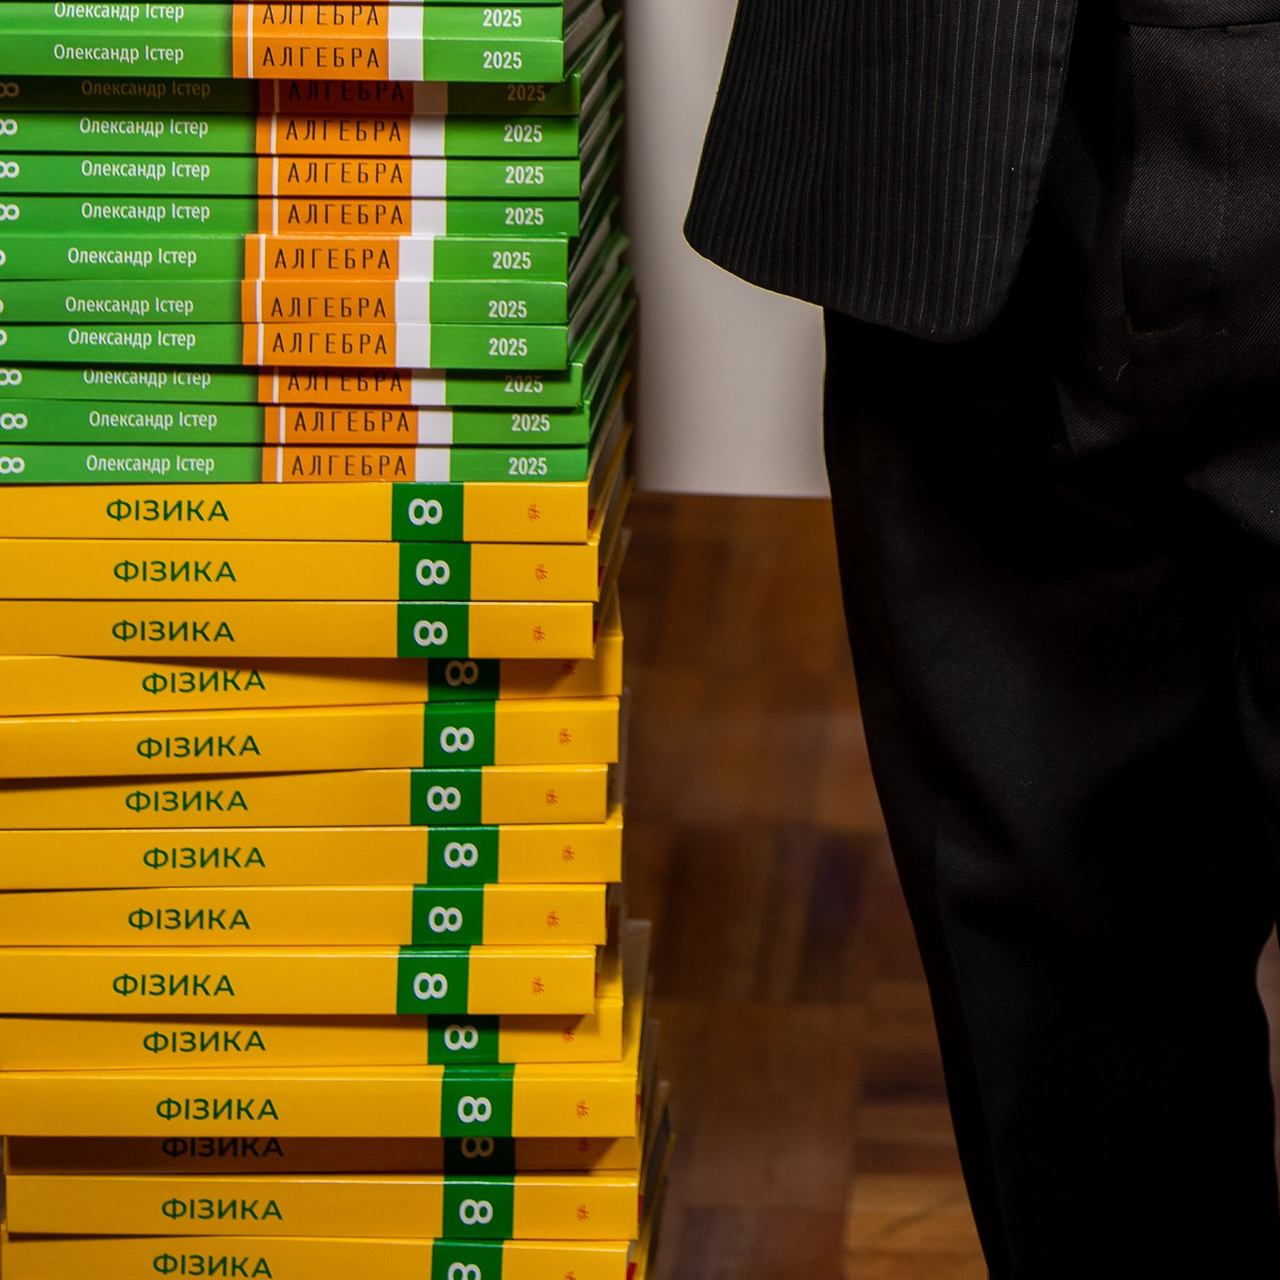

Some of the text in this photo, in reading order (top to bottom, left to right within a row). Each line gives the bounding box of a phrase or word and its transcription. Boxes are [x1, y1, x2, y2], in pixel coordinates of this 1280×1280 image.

[55, 2, 522, 27] Олександр Істер АЛГЕБРА 2025
[54, 44, 522, 69] Олександр Істер АЛГЕБРА 2025
[80, 117, 542, 142] Олександр Істер АЛГЕБРА 2025
[82, 160, 544, 184] Олександр Істер АЛГЕБРА 2025
[82, 202, 544, 225] Олександр Істер АЛГЕБРА 2025
[68, 247, 531, 269] Олександр Істер АЛГЕБРА 2025
[66, 296, 527, 318] Олександр Істер АЛГЕБРА 2025
[69, 328, 527, 356] Олександр Істер АЛГЕБРА 2025
[84, 369, 544, 394] Олександр Істер АЛГЕБРА 2025
[0, 411, 550, 431] 8 Олександр Істер АЛГЕБРА 2025
[87, 455, 547, 475] Олександр Істер АЛГЕБРА 2025
[107, 498, 442, 525] ФІЗИКА 8
[114, 559, 450, 585] ФІЗИКА 8
[112, 620, 448, 646] ФІЗИКА 8
[142, 669, 266, 695] ФІЗИКА
[137, 727, 474, 759] ФІЗИКА 8
[126, 786, 461, 812] ФІЗИКА 8
[143, 842, 478, 869] ФІЗИКА 8
[128, 906, 463, 932] ФІЗИКА 8
[113, 972, 448, 999] ФІЗИКА 8
[143, 1026, 478, 1053] ФІЗИКА 8
[157, 1096, 492, 1123] ФІЗИКА 8
[162, 1198, 493, 1224] ФІЗИКА 8
[153, 1253, 272, 1278] ФІЗИКА
